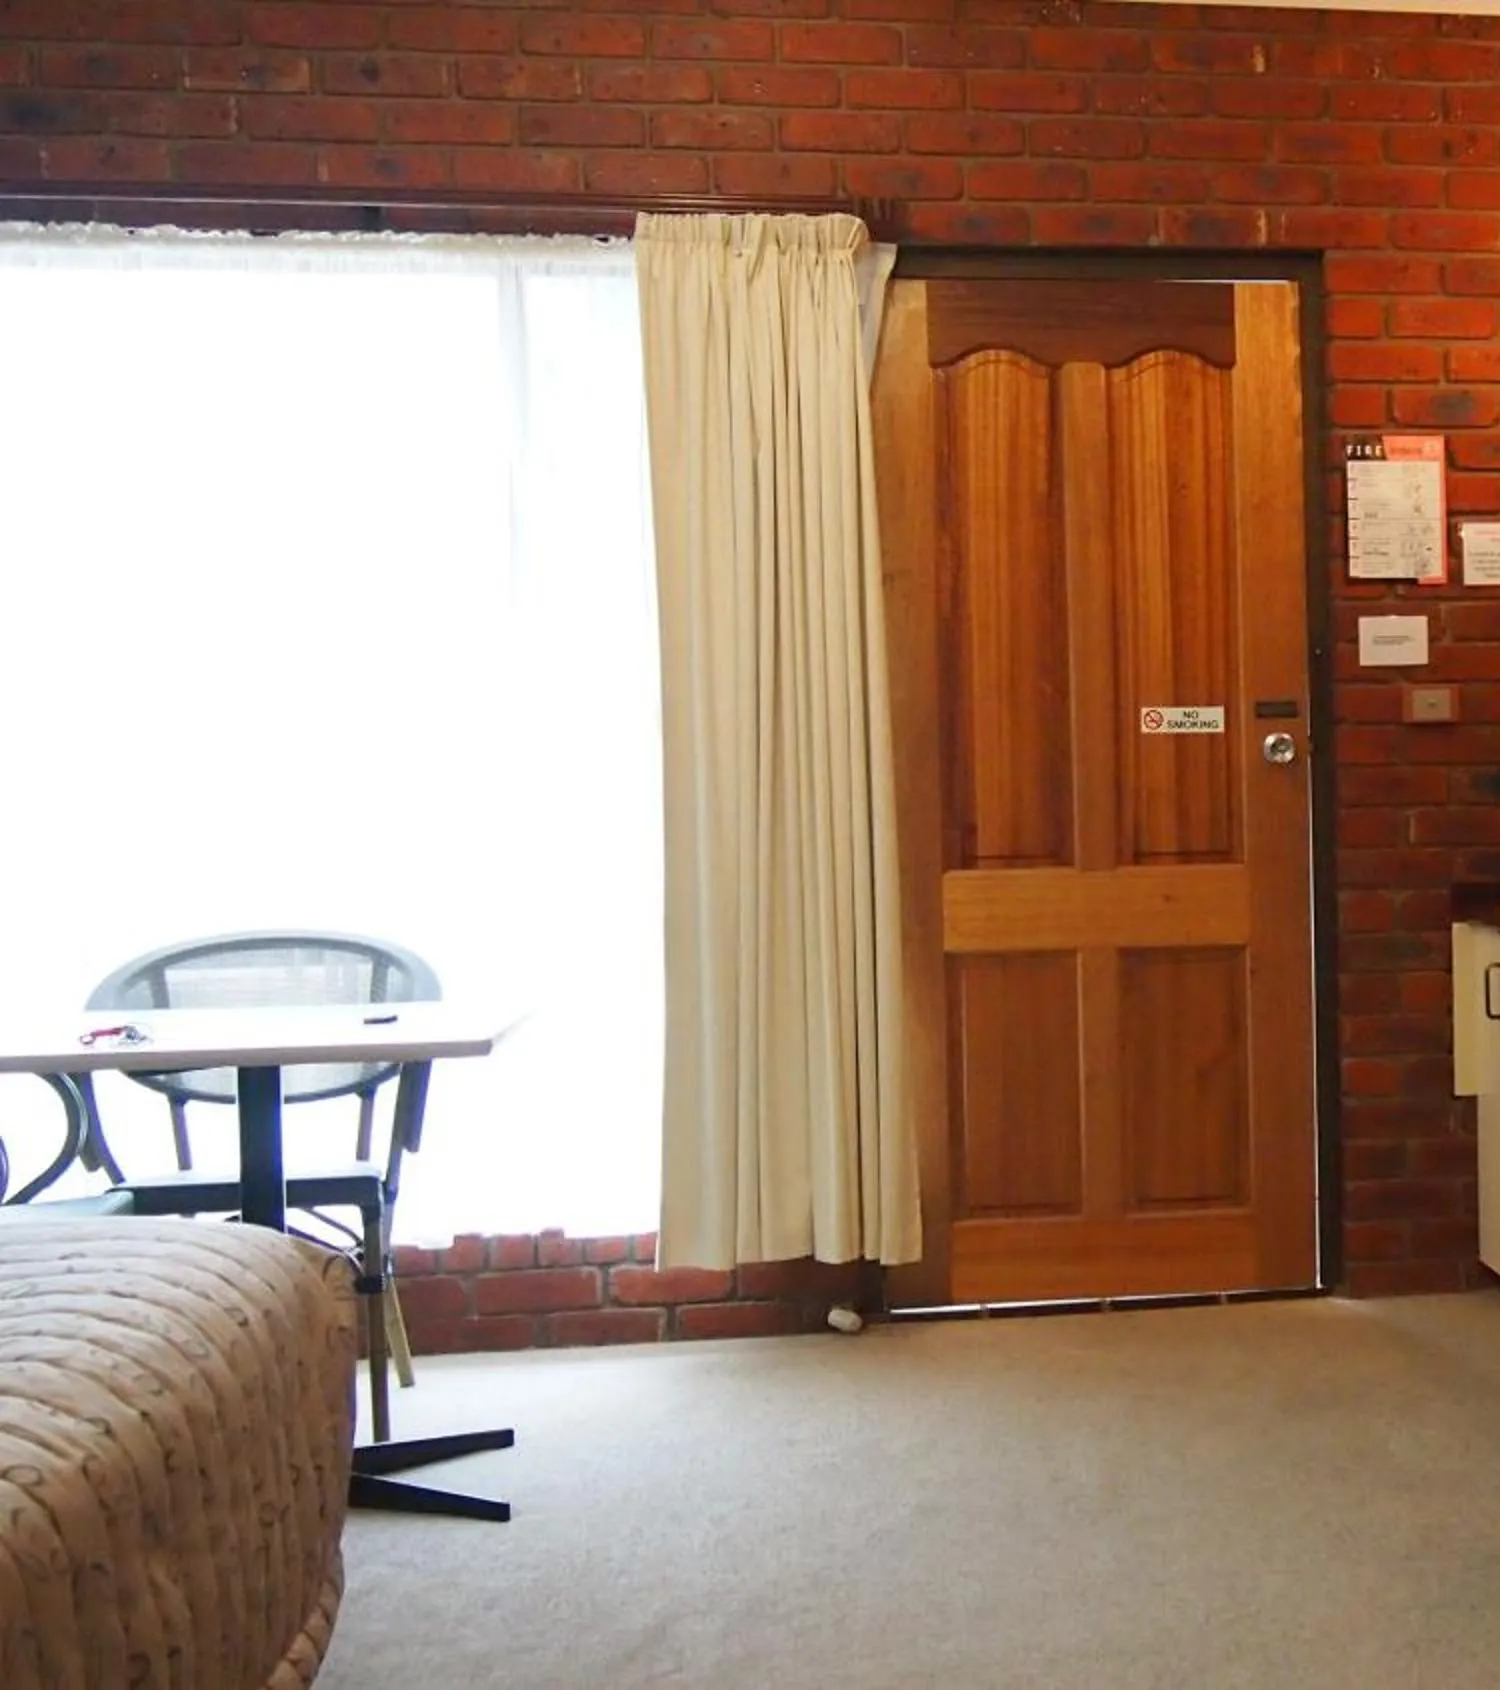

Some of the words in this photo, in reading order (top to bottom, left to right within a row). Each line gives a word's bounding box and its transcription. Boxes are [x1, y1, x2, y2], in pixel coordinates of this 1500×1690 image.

[1346, 445, 1384, 456] FIRE
[1183, 710, 1199, 719] NO
[1166, 720, 1219, 729] SMOKING
